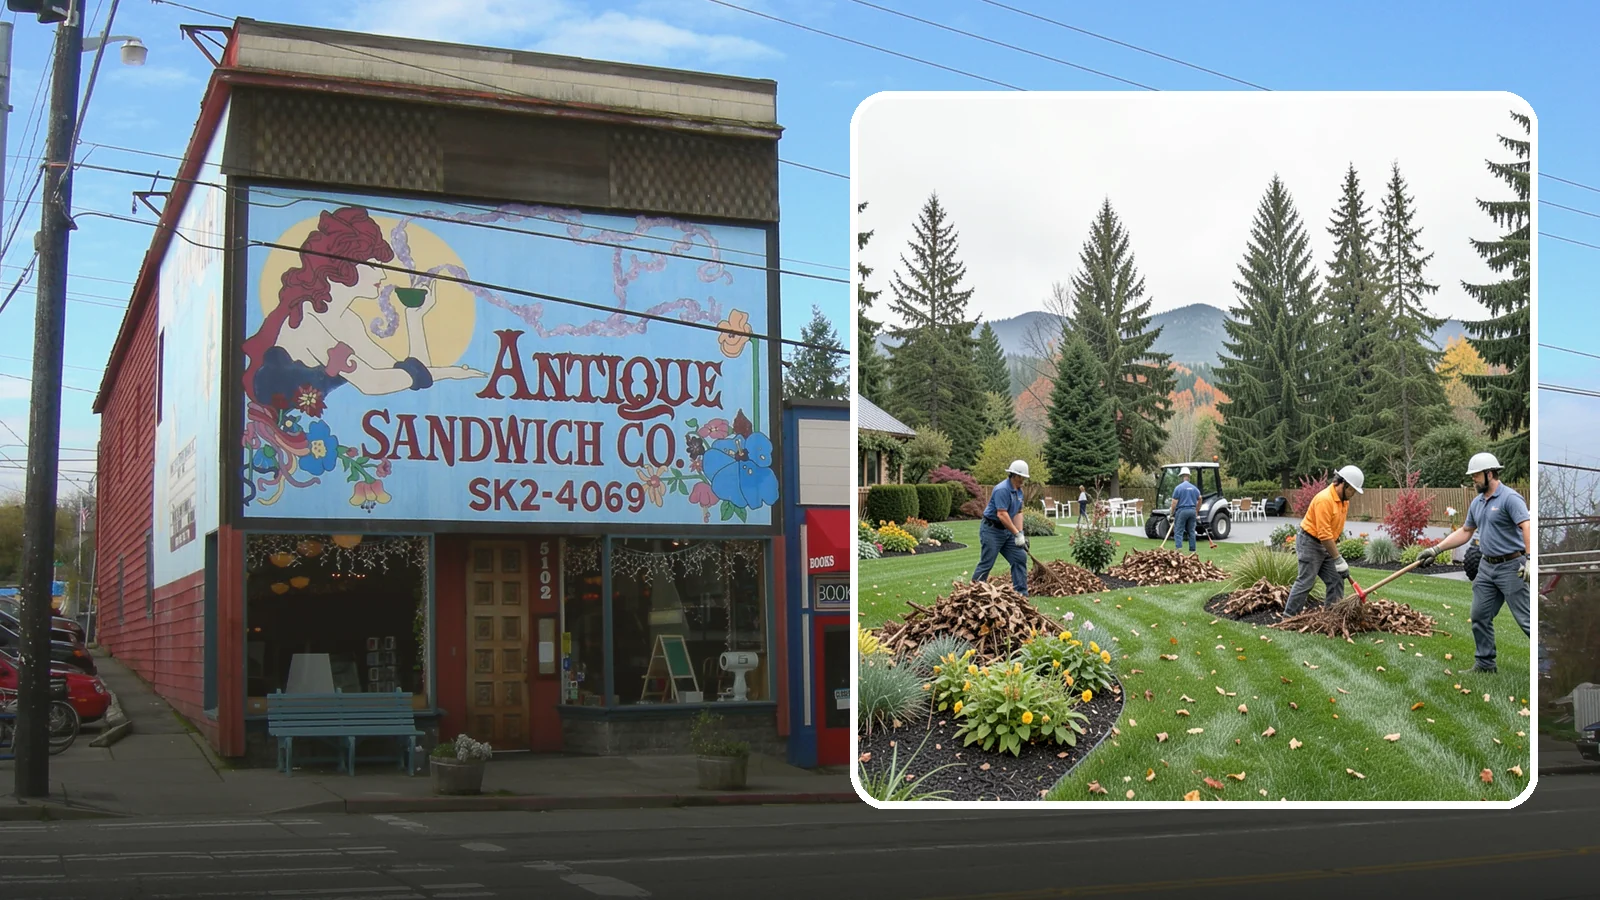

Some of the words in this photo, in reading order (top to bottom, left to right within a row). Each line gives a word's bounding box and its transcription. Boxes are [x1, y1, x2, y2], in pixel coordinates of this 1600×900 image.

[476, 329, 724, 421] ANTIQUE
[361, 408, 605, 467] SANDWICH
[617, 422, 685, 469] CO.
[468, 477, 647, 512] SK2-4069
[540, 541, 551, 599] 5102
[809, 555, 835, 569] BOOKS
